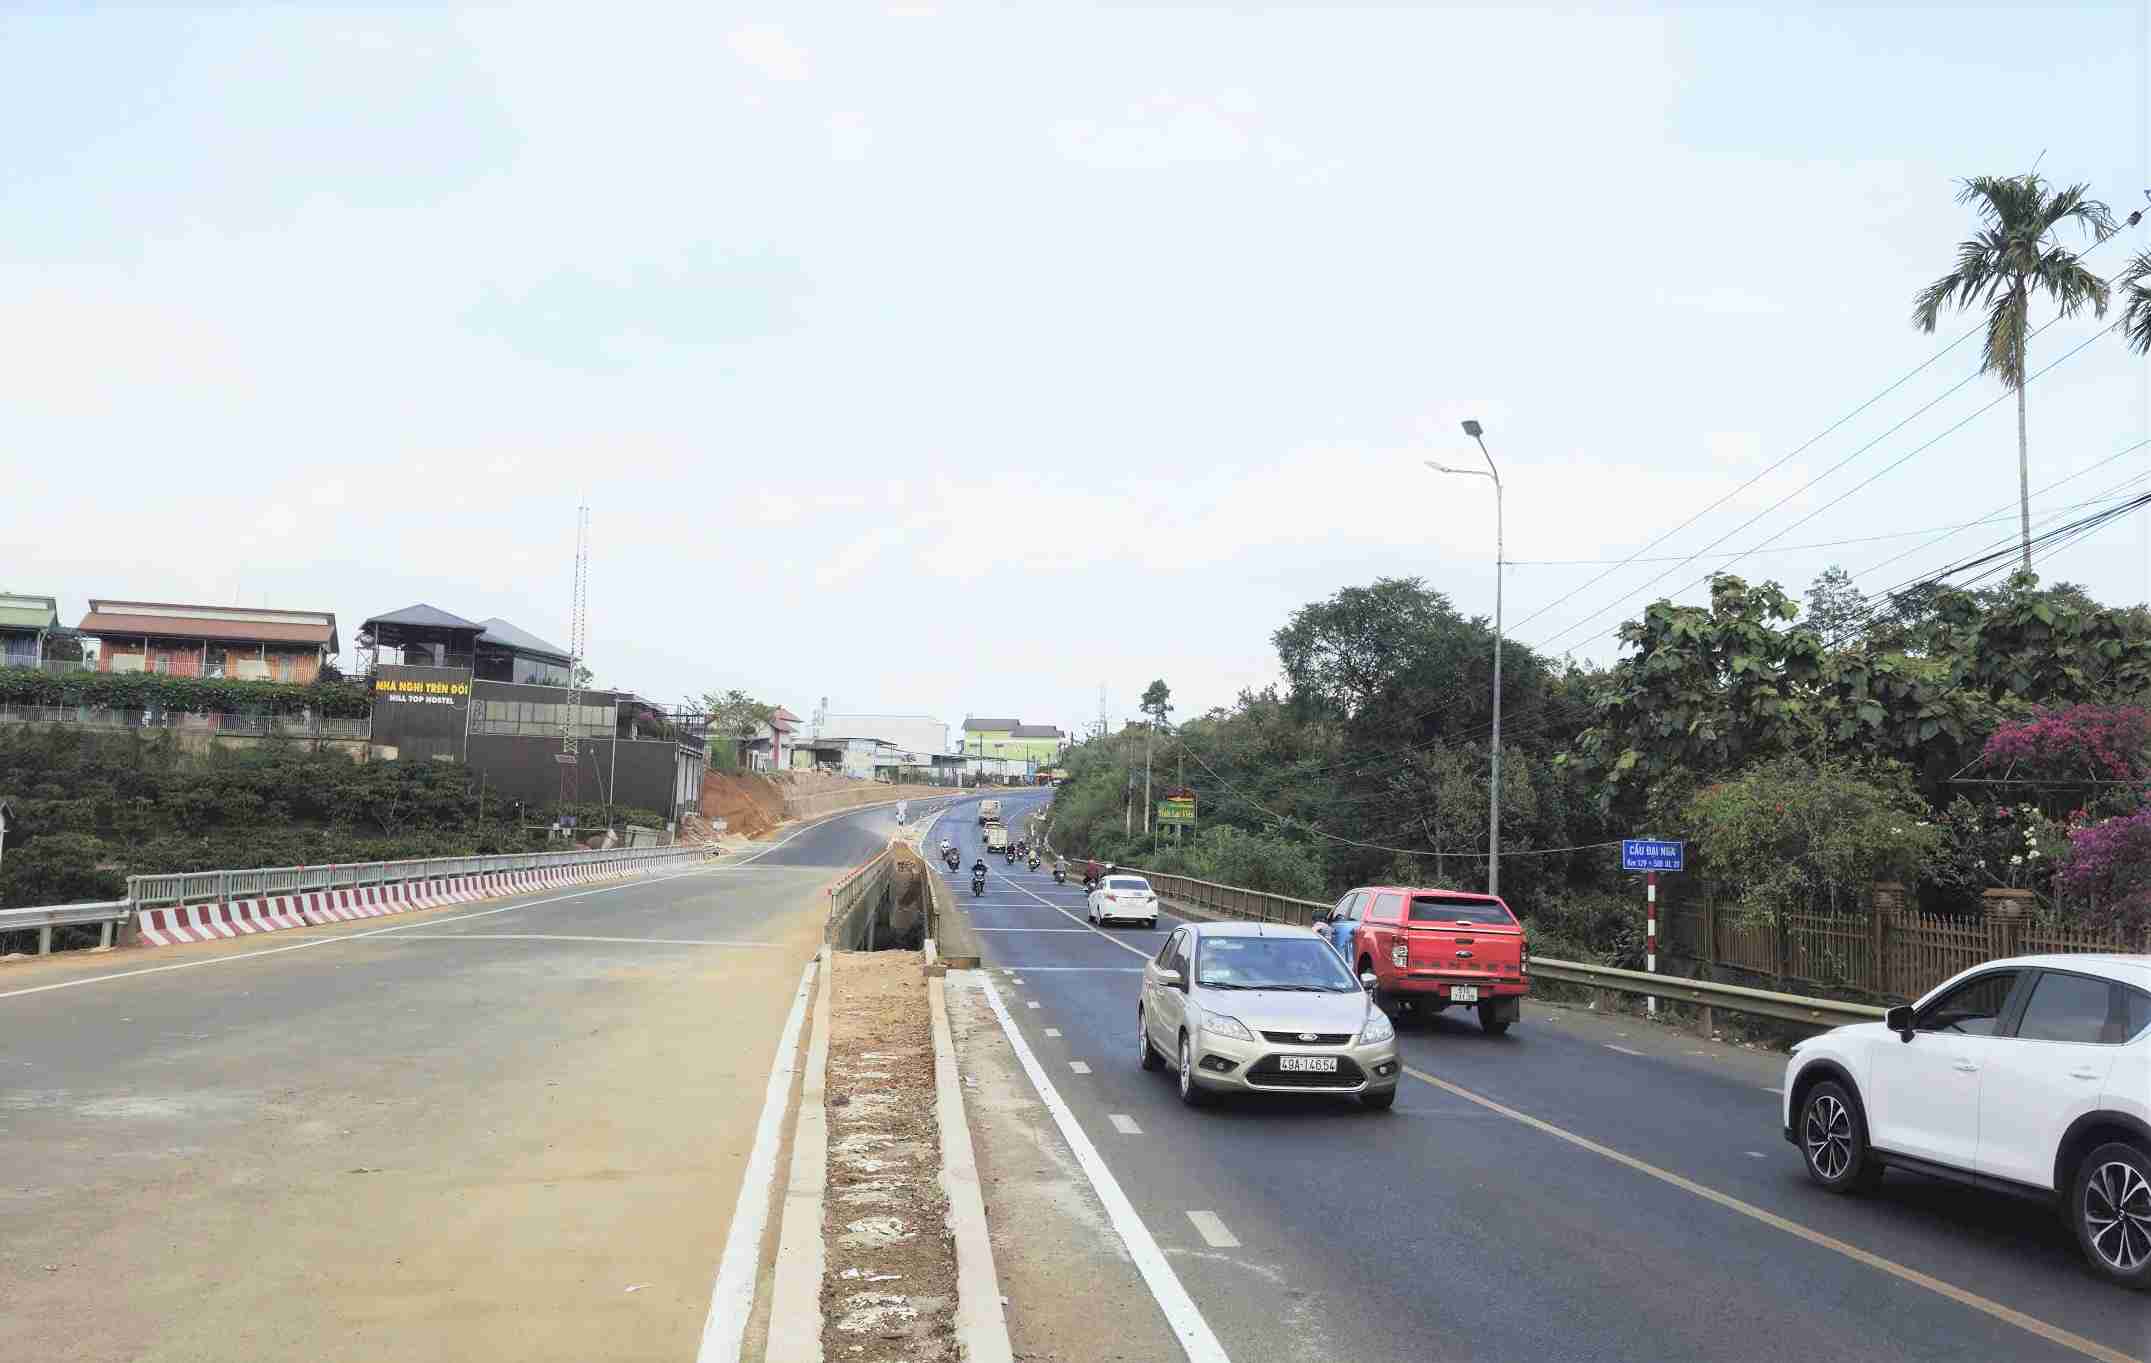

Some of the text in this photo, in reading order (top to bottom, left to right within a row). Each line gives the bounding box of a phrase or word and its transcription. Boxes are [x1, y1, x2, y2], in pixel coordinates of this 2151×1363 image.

[389, 694, 454, 704] HILL TOP HOSTEL
